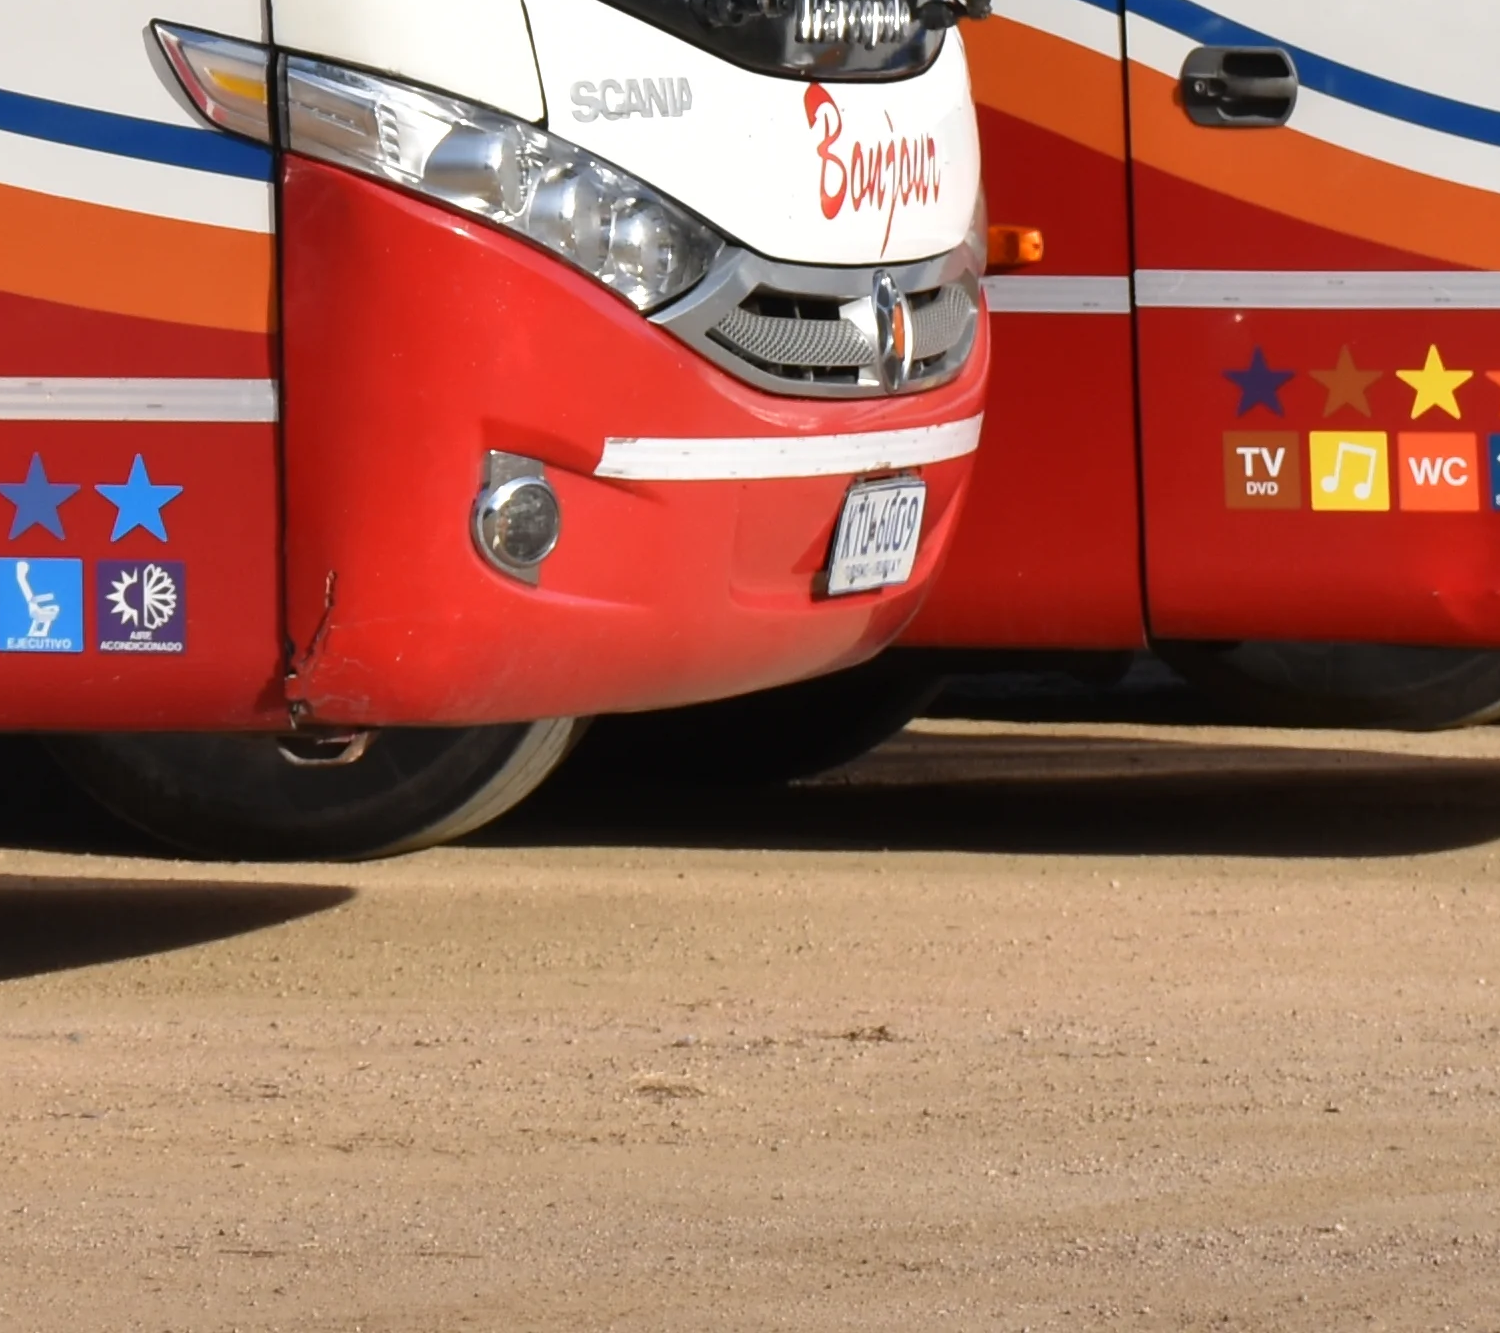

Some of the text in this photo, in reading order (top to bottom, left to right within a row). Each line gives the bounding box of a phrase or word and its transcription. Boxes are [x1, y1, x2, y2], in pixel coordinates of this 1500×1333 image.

[570, 76, 693, 123] SCANIA
[803, 82, 942, 259] Bonjour
[1236, 447, 1286, 478] TV
[1408, 455, 1468, 487] WC
[1245, 482, 1279, 497] DVD
[6, 637, 72, 651] EJECUTIVO
